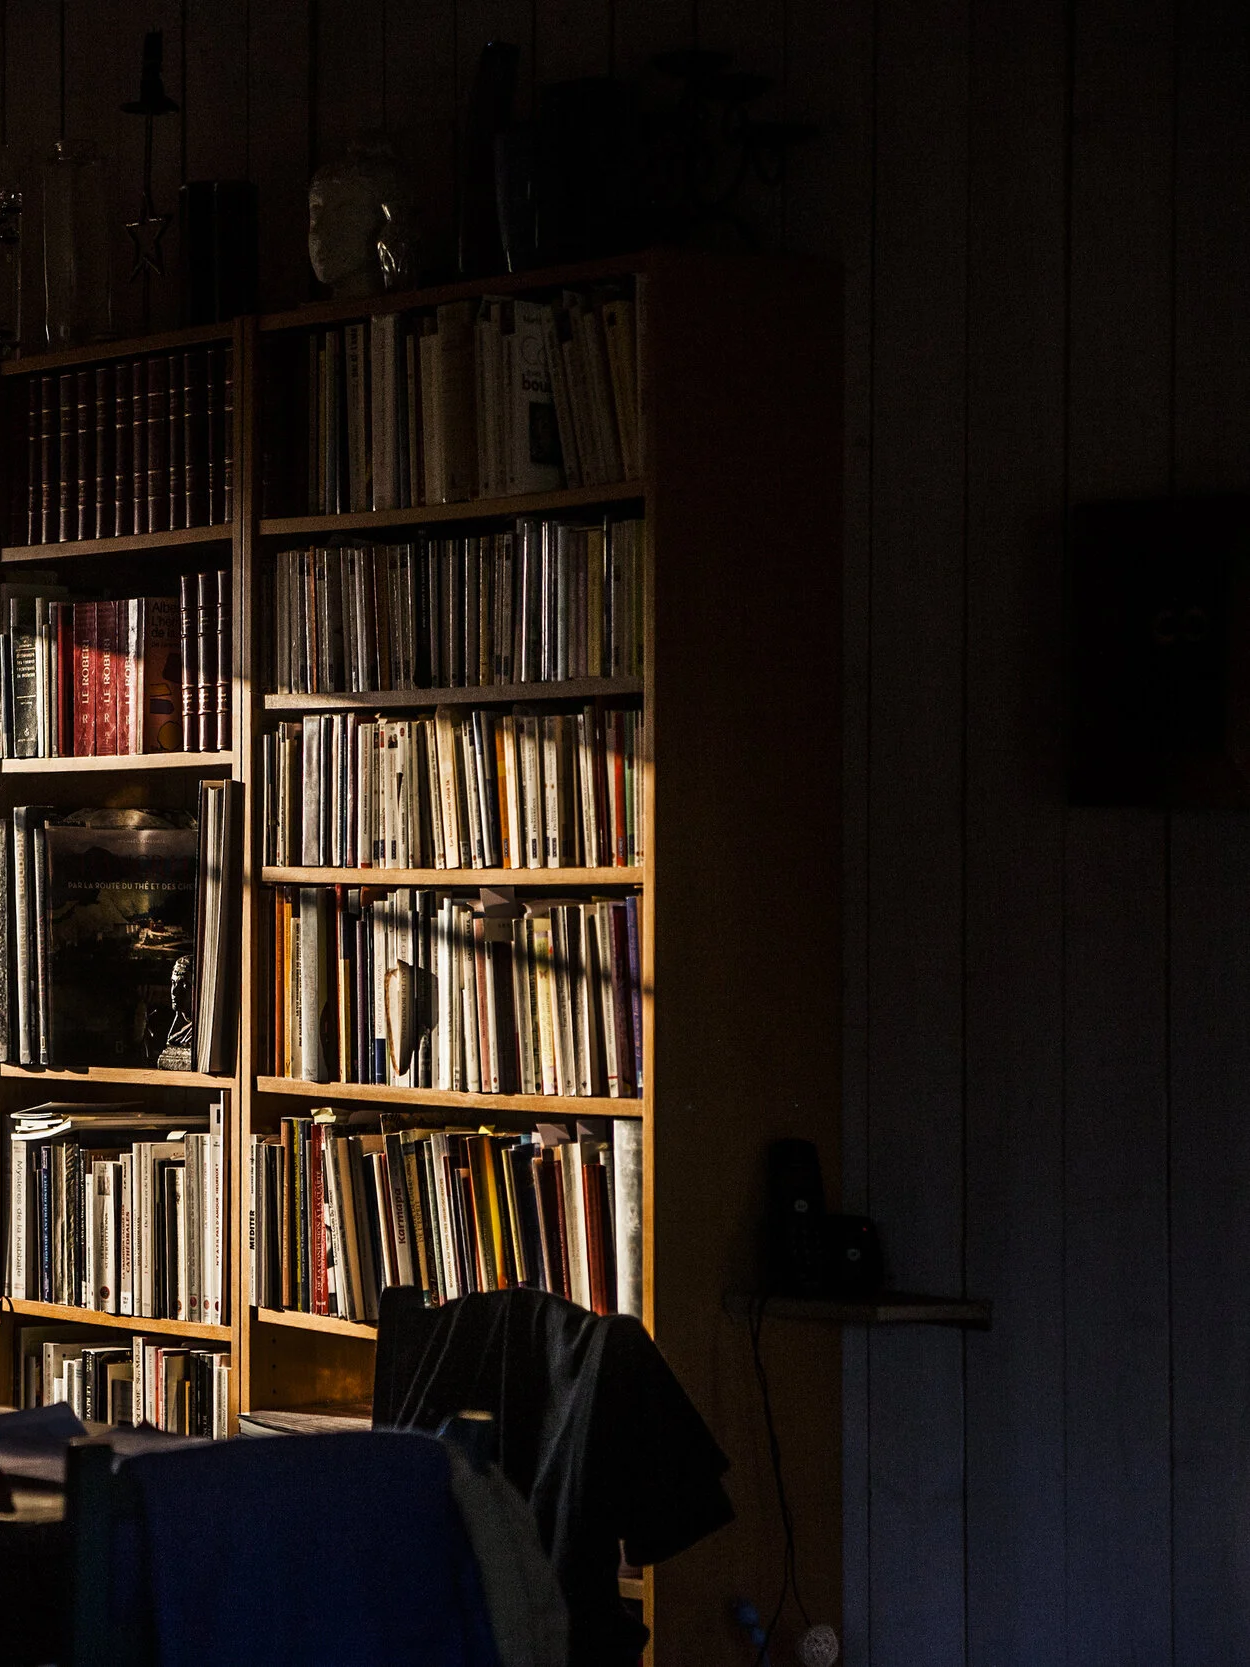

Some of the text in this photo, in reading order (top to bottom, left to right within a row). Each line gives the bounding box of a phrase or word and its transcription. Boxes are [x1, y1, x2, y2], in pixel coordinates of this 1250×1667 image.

[103, 638, 111, 703] LE ROBERT
[82, 691, 89, 704] LE
[16, 831, 25, 895] BOUDDHA
[95, 882, 120, 890] ROUTE
[134, 880, 149, 890] THÉ
[150, 882, 159, 890] ET
[162, 882, 176, 890] DES
[16, 1208, 24, 1221] de
[394, 1188, 406, 1245] Karmapa
[16, 1224, 24, 1234] la
[86, 1385, 92, 1396] LE
